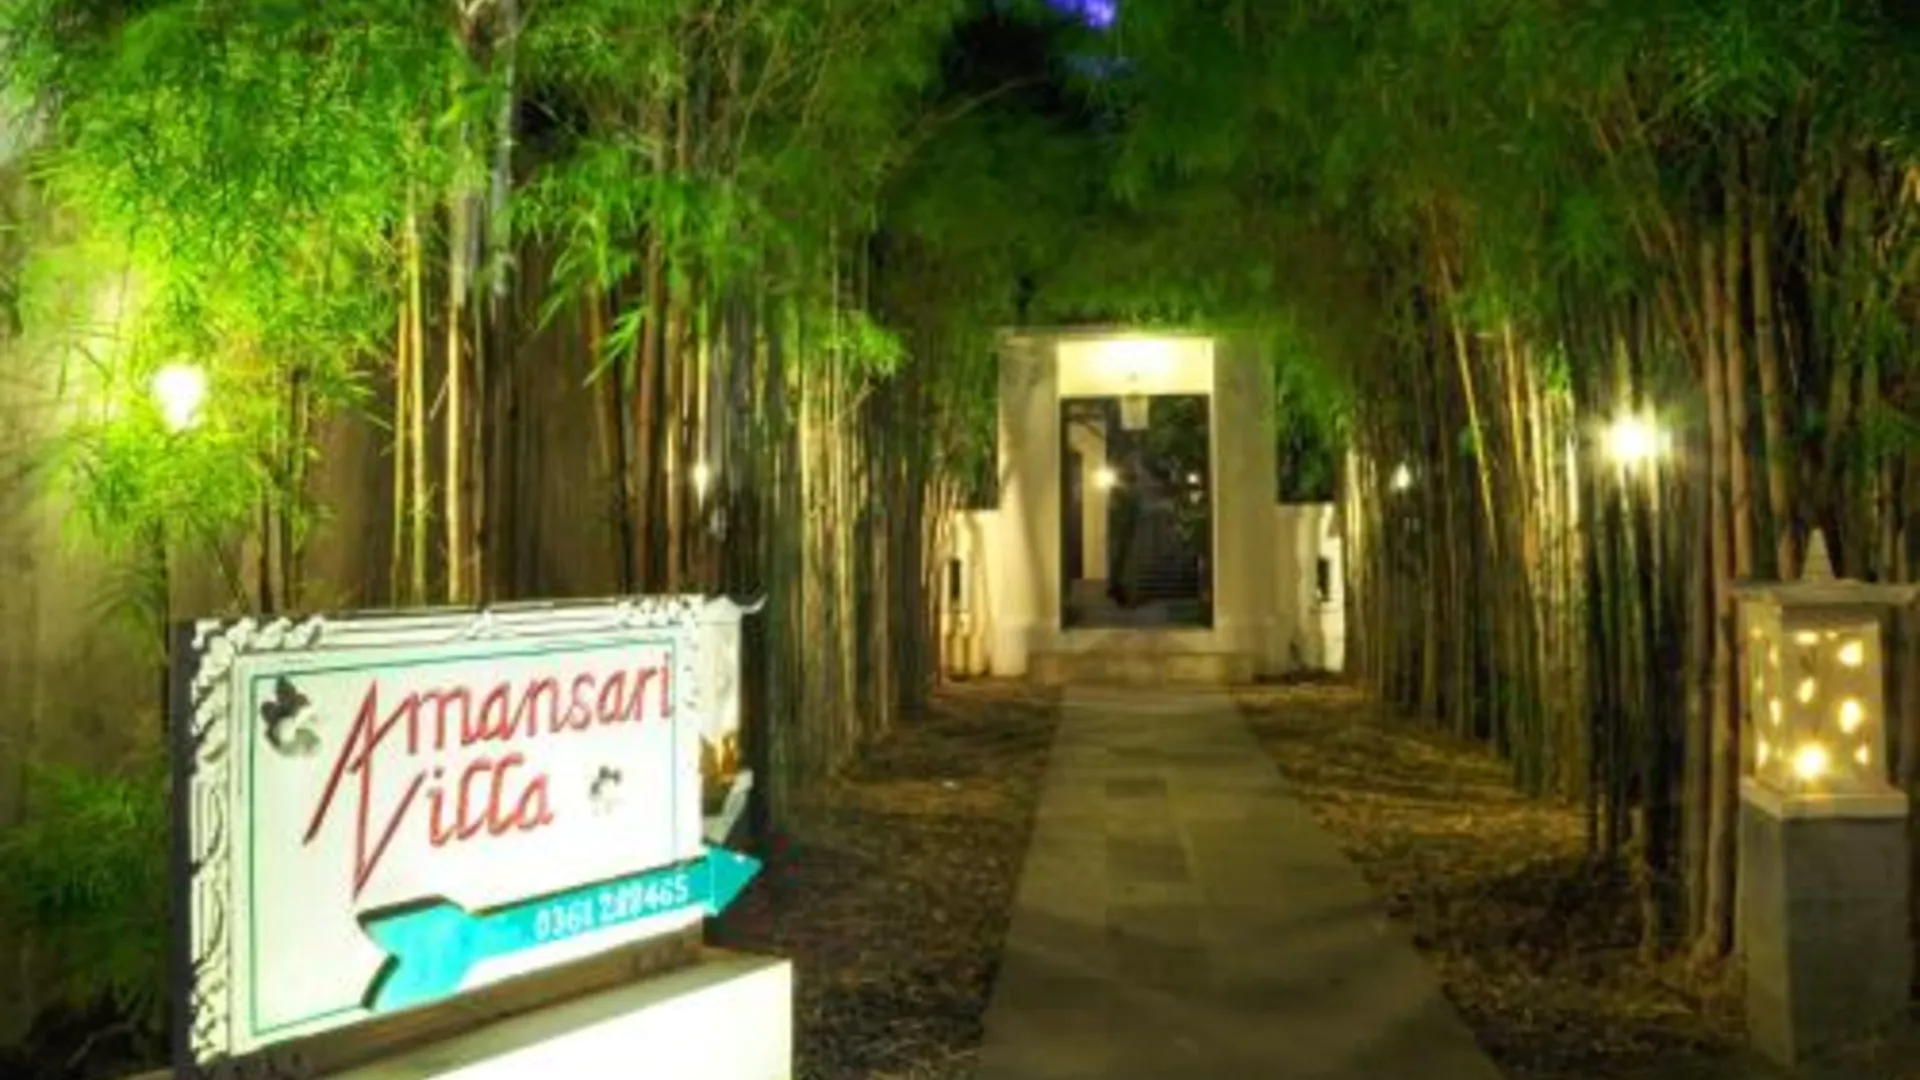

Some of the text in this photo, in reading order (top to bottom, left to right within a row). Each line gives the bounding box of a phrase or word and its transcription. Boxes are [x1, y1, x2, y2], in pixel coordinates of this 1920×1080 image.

[303, 652, 672, 845] Amansari
[353, 752, 554, 900] Villa
[535, 897, 594, 941] 0361
